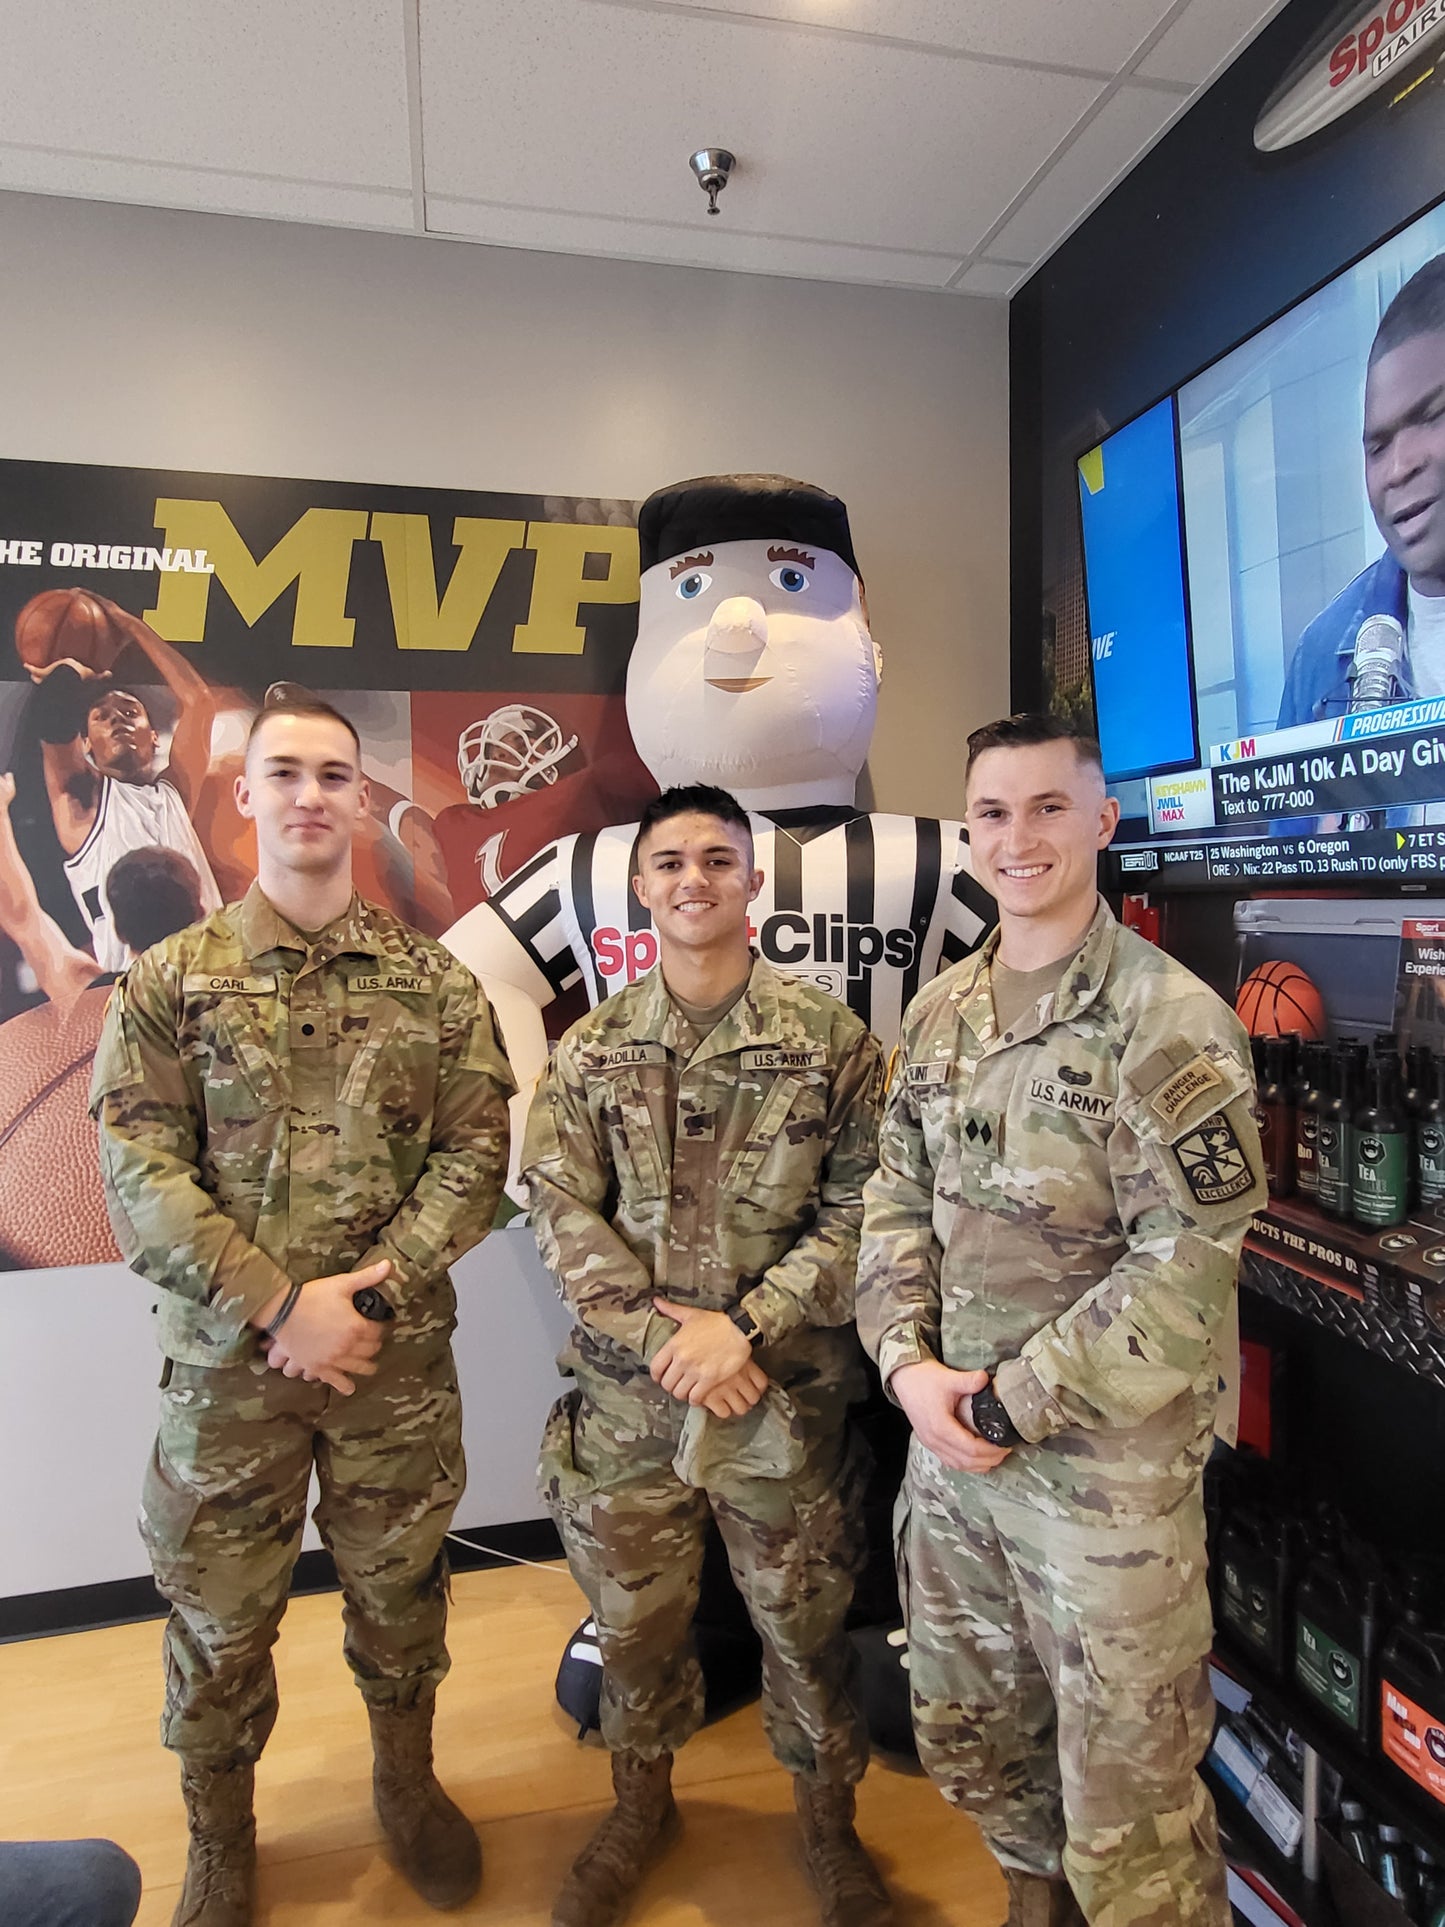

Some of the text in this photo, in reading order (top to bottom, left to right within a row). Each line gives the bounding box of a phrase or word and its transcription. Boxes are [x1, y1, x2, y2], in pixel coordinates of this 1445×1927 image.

[50, 542, 215, 573] ORIGINAL
[142, 498, 640, 655] MVP
[1219, 739, 1256, 762] KJM
[1219, 773, 1250, 795] The
[1254, 762, 1294, 790] KJM
[1300, 758, 1336, 783] 10k
[1340, 753, 1357, 777] A
[1362, 749, 1406, 776] Day
[1157, 796, 1183, 810] JWILL
[1221, 789, 1314, 816] Text to 777-000
[1162, 808, 1185, 821] MAX
[1210, 840, 1350, 860] 25 Washington vs 6 Oregon
[1408, 834, 1415, 848] 7
[1418, 833, 1435, 847] ET
[1164, 850, 1203, 862] NCAAF T25
[1213, 865, 1231, 877] ORE
[1262, 862, 1274, 875] 22
[1276, 861, 1297, 874] Pass
[1331, 858, 1358, 871] Rush
[1360, 857, 1376, 871] TD
[1379, 856, 1408, 872] (only
[1411, 854, 1437, 868] FBS
[1415, 922, 1439, 933] Sport
[761, 913, 915, 976] Clips
[210, 977, 249, 991] CARL
[357, 976, 424, 991] U.S. ARMY
[754, 1053, 813, 1067] U.S. ARMY
[1163, 1071, 1196, 1101] RANGER
[1165, 1073, 1211, 1114] CHALLENGE
[1030, 1081, 1112, 1115] U.S. ARMY
[1358, 1164, 1377, 1181] TEA
[1200, 1174, 1250, 1199] EXCELLENCE
[1251, 1218, 1280, 1241] UCTS
[1283, 1230, 1306, 1251] THE
[1309, 1241, 1342, 1267] PROS
